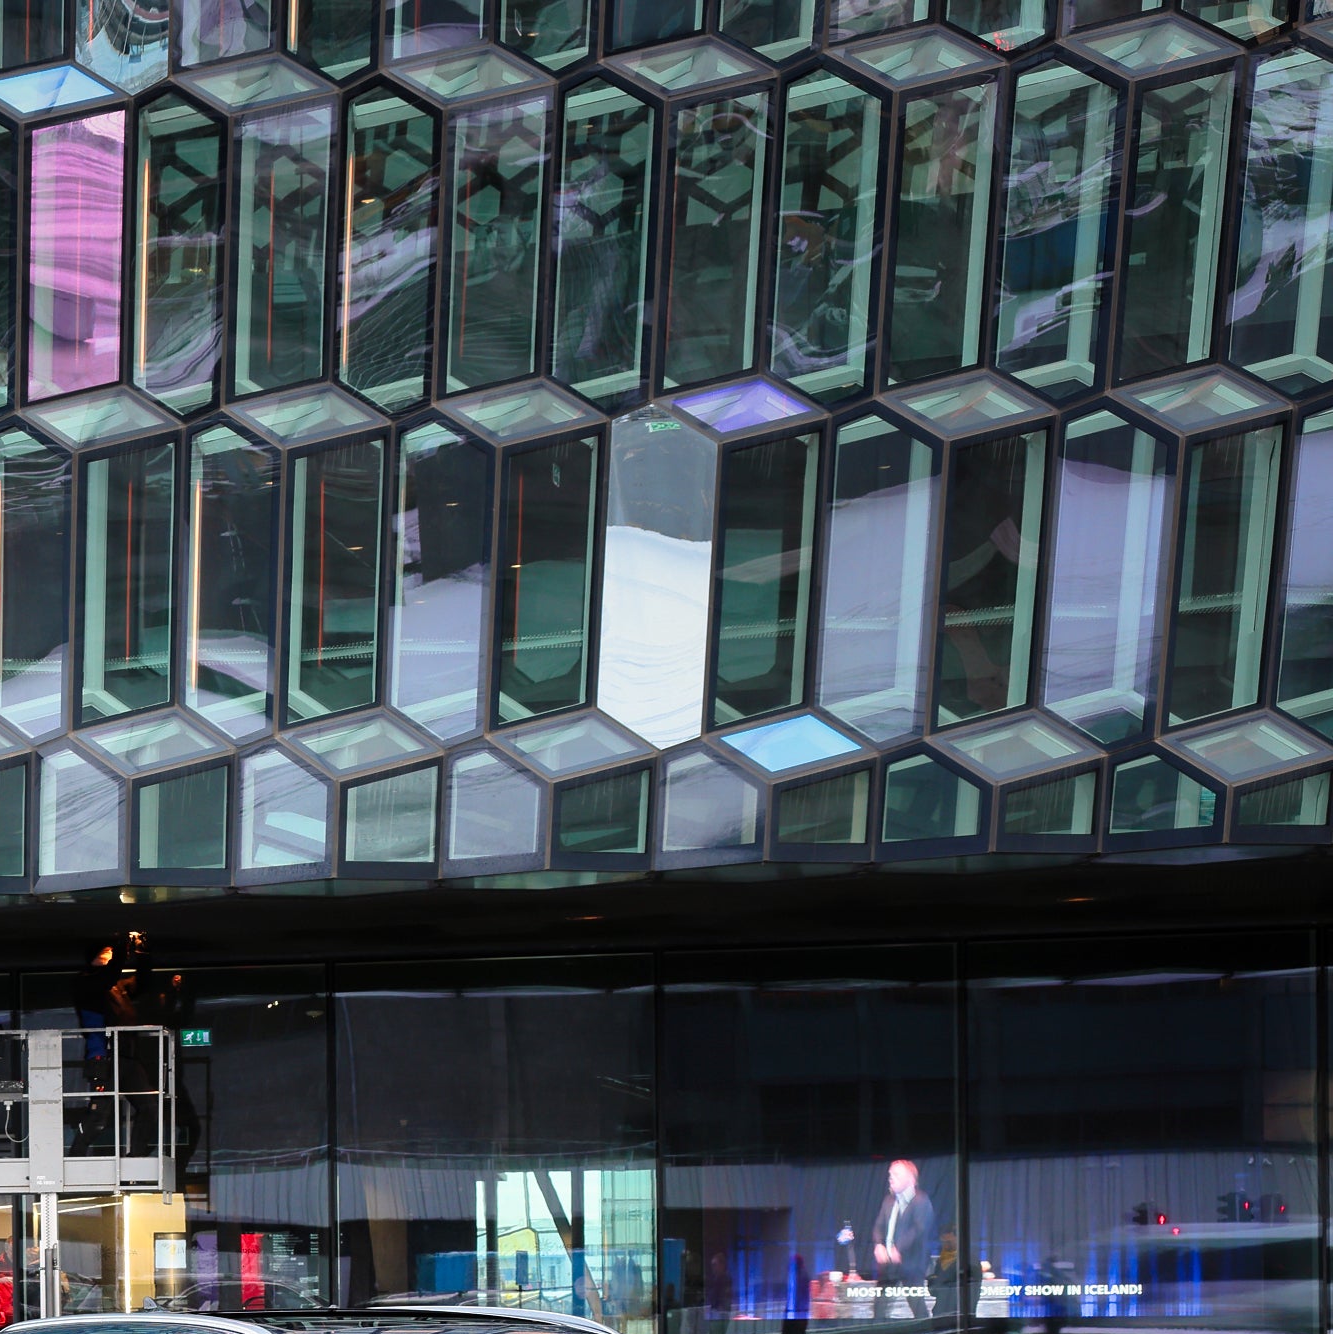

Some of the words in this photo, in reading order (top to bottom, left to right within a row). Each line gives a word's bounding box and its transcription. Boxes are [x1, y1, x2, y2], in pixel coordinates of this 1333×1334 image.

[846, 1287, 883, 1297] MOST
[1024, 1285, 1064, 1296] SHOW
[1067, 1284, 1081, 1295] IN
[1084, 1284, 1143, 1295] ICELAND!
